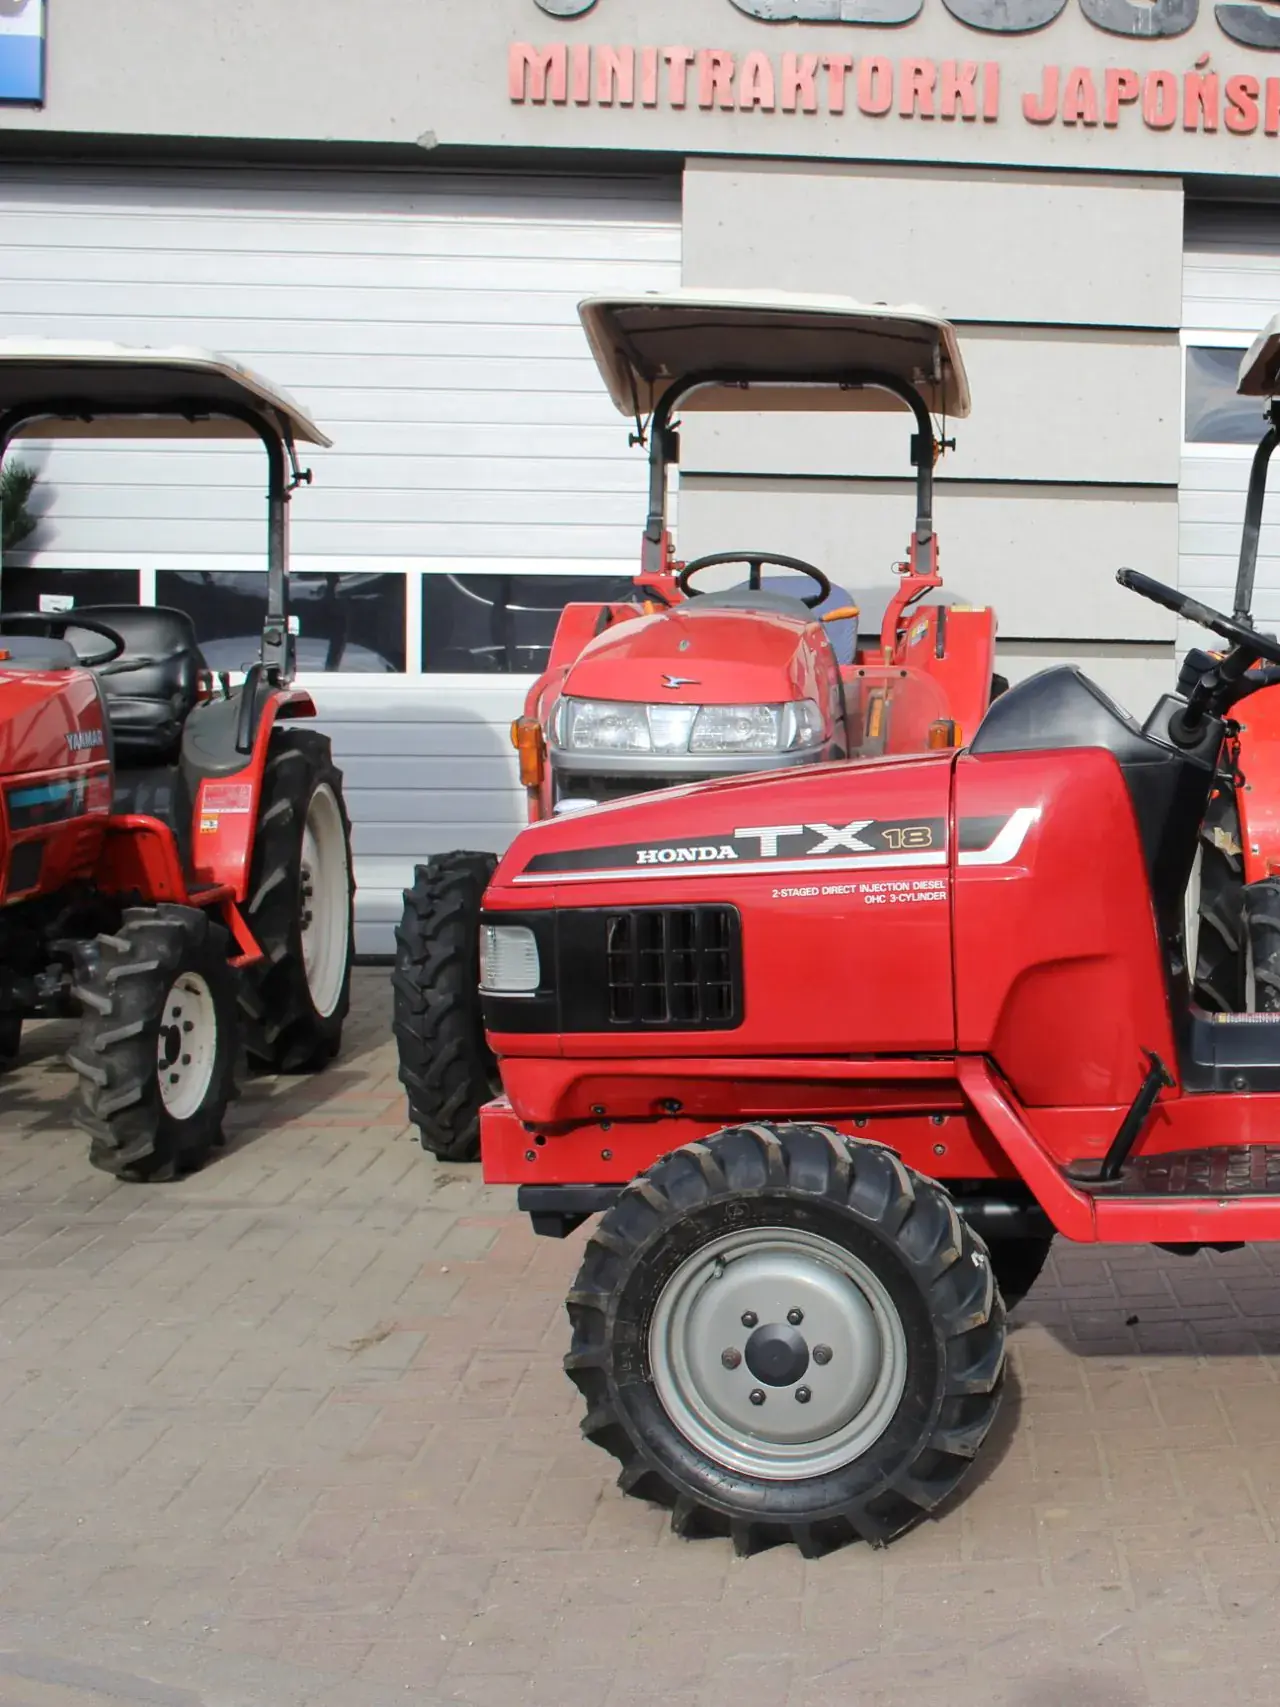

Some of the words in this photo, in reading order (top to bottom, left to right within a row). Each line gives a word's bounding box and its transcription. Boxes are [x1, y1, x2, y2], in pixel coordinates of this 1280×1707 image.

[508, 41, 1000, 123] MINITRAKTORKI
[636, 845, 739, 865] HONDA
[734, 819, 877, 858] TX
[881, 826, 932, 849] 18
[772, 887, 819, 898] 2-STAGED
[822, 884, 856, 895] DIRECT
[859, 882, 910, 893] INJECTION
[913, 880, 946, 890] DIESEL
[864, 894, 886, 904] OHC
[889, 891, 947, 903] 3-CYLINDER
